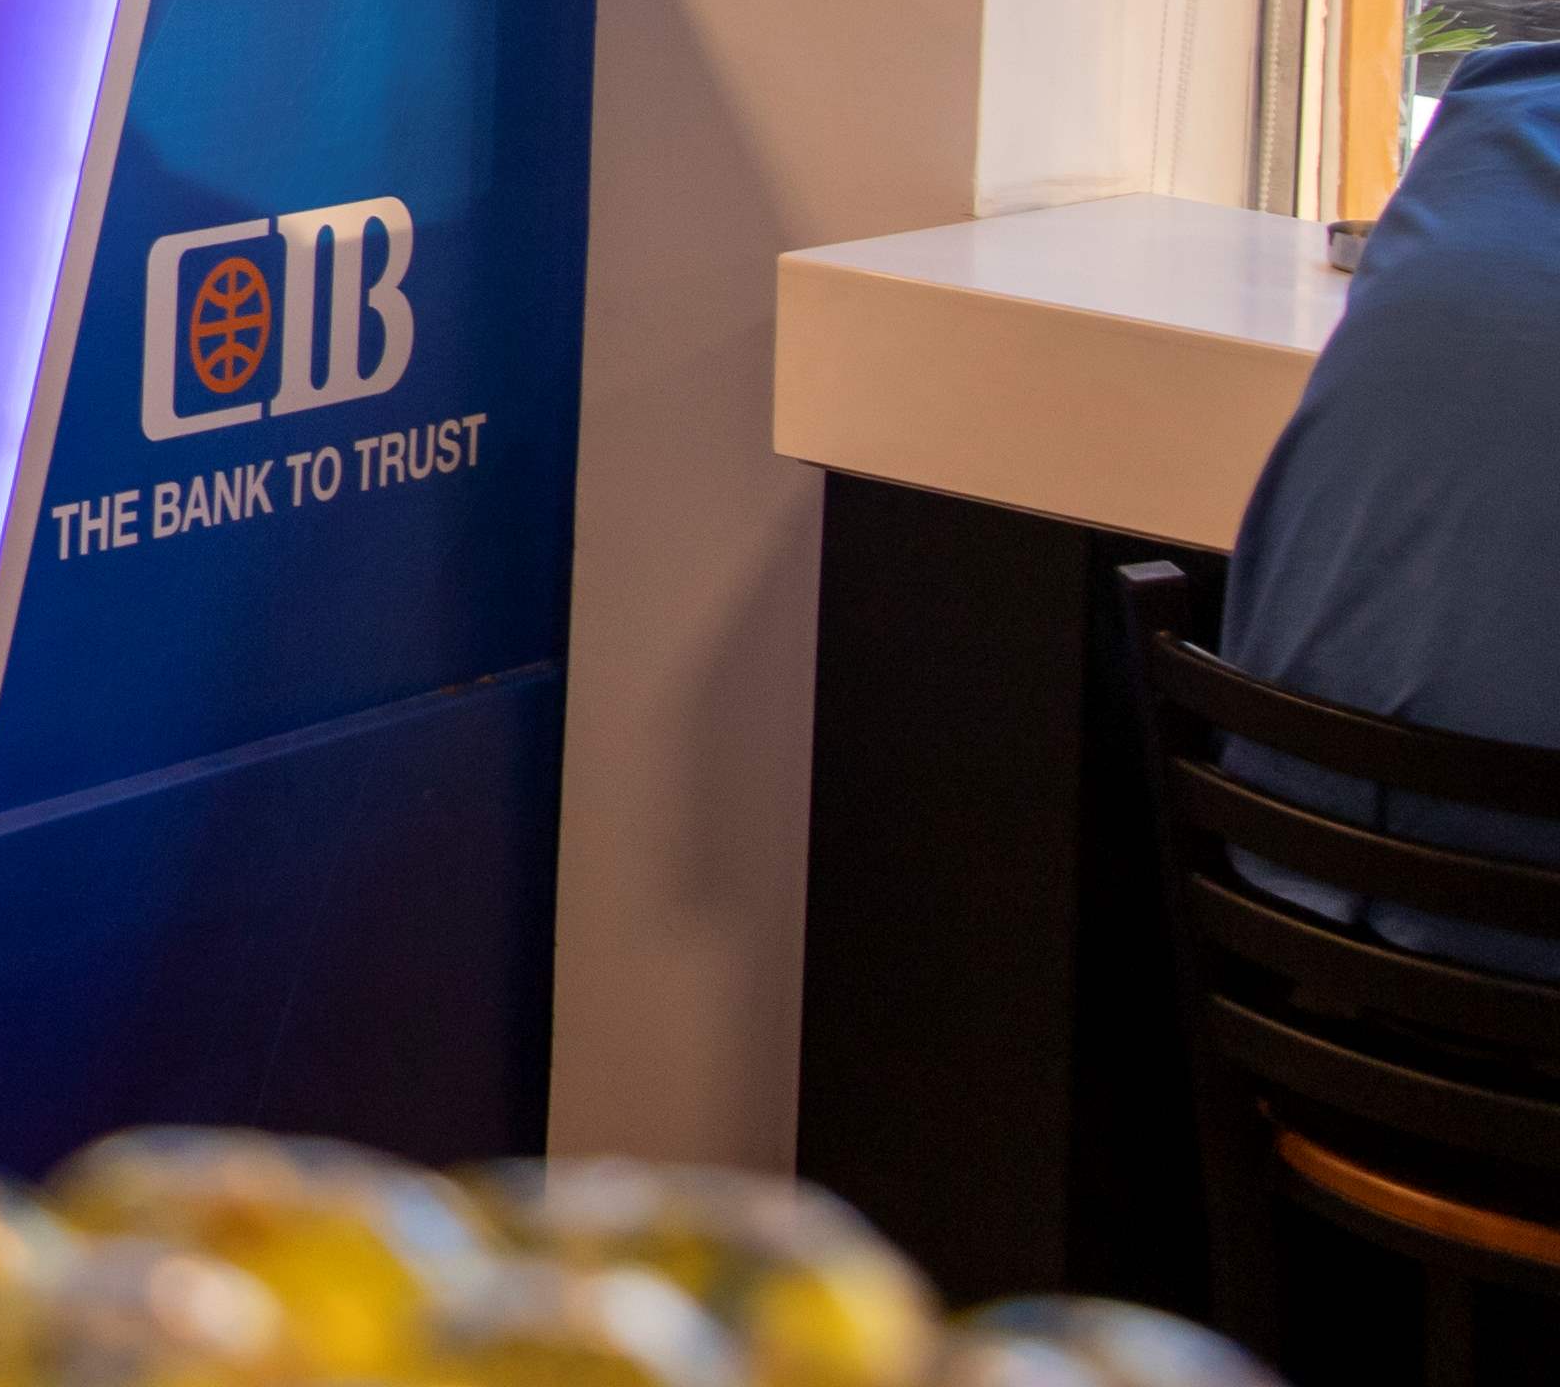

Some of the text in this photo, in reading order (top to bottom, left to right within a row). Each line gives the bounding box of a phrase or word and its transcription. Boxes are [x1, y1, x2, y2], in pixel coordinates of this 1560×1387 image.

[141, 195, 415, 442] CIB
[51, 413, 488, 561] THE BANK TO TRUST
